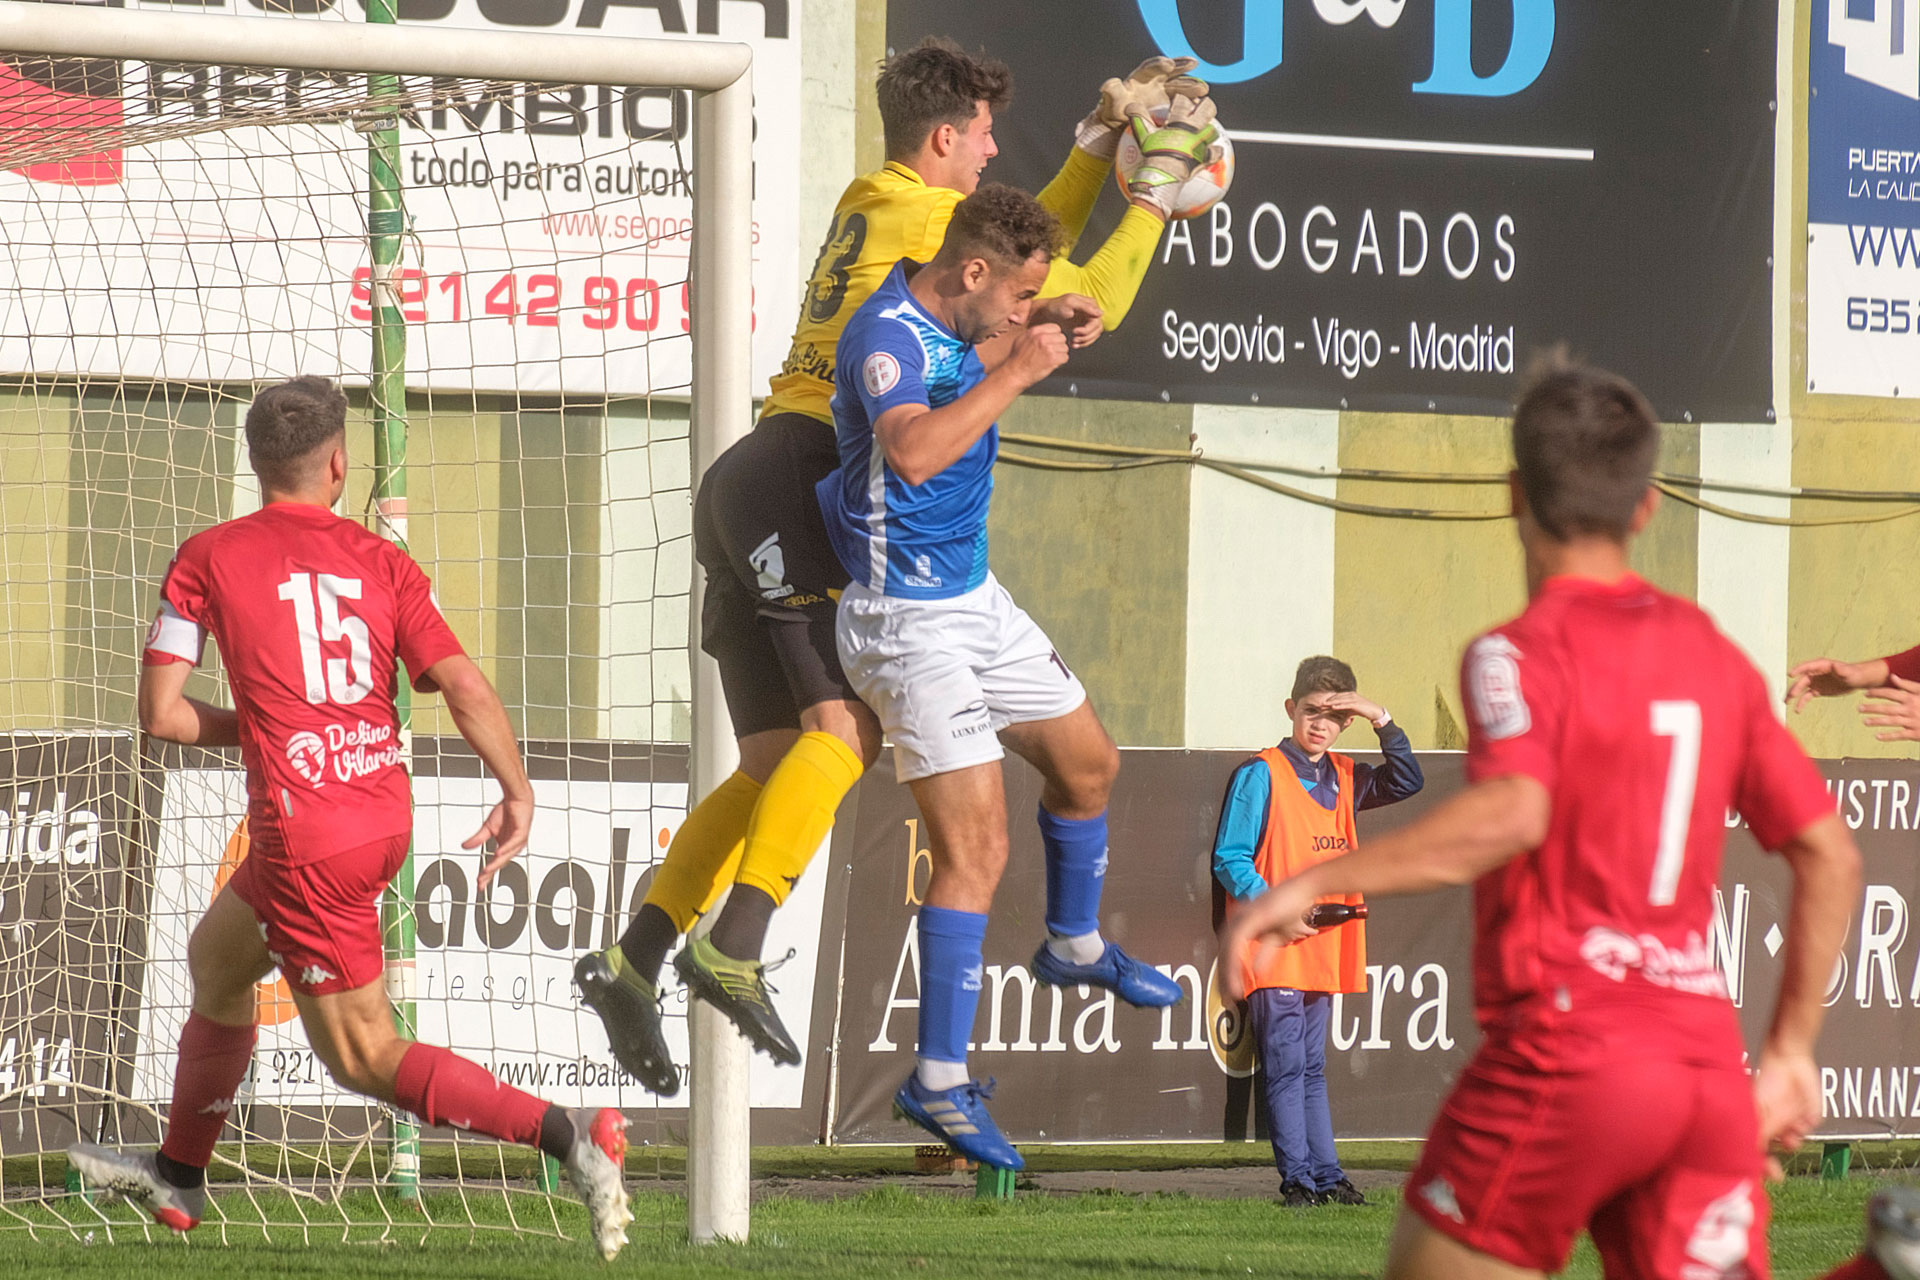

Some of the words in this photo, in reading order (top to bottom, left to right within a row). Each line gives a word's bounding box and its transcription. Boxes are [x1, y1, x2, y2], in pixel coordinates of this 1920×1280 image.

[412, 147, 490, 188] todo
[503, 160, 582, 200] para
[1848, 178, 1871, 199] LA
[1163, 202, 1516, 283] ABOGADOS
[484, 273, 562, 328] 42
[582, 276, 661, 332] 90
[1163, 310, 1285, 373] Segovia
[1312, 317, 1382, 379] Vigo
[1410, 322, 1515, 374] Madrid
[277, 572, 374, 706] 15
[0, 792, 99, 865] ida
[1649, 699, 1702, 907] 7
[868, 914, 1122, 1053] Ama
[272, 1050, 316, 1084] 921
